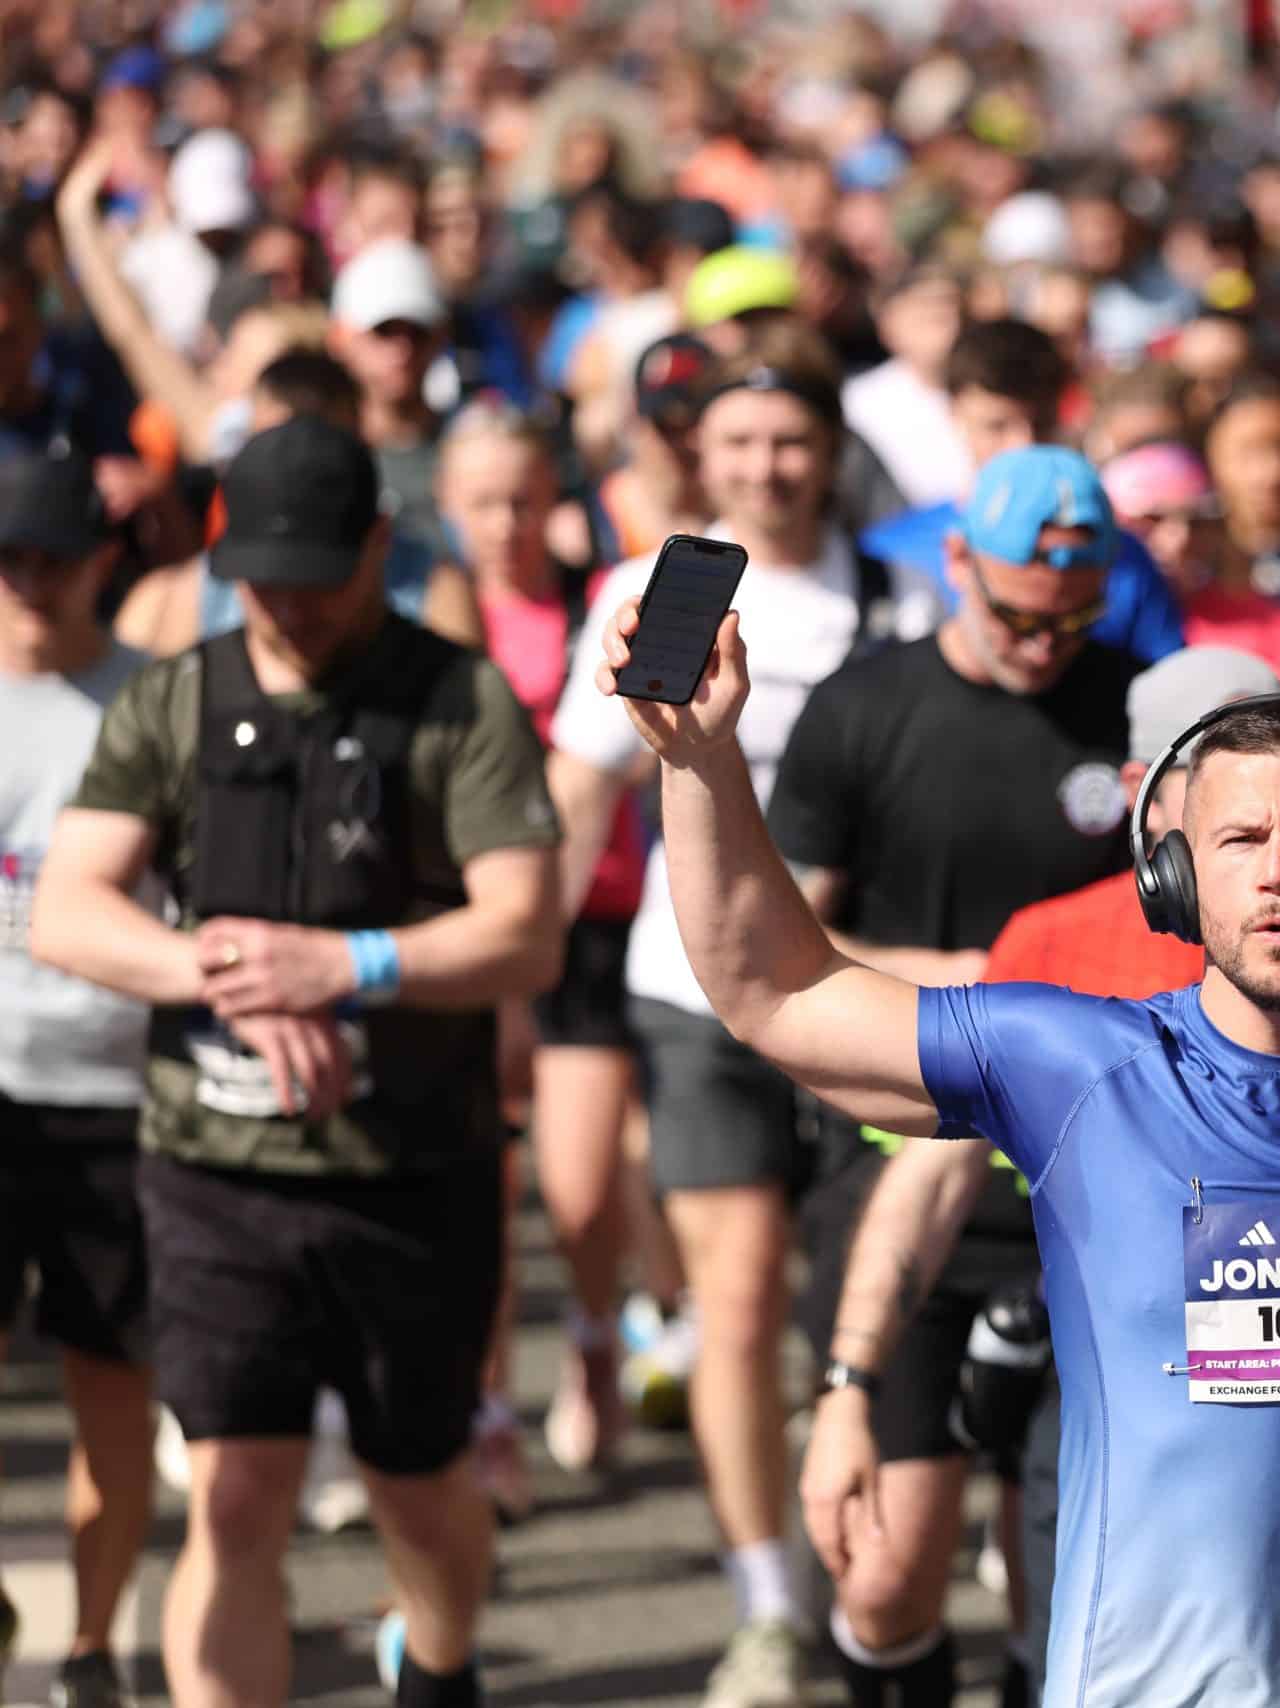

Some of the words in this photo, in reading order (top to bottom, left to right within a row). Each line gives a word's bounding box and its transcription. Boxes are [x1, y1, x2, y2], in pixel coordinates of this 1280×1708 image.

[1205, 1359, 1238, 1369] START
[1239, 1359, 1270, 1369] AREA:
[1209, 1385, 1269, 1395] EXCHANGE
